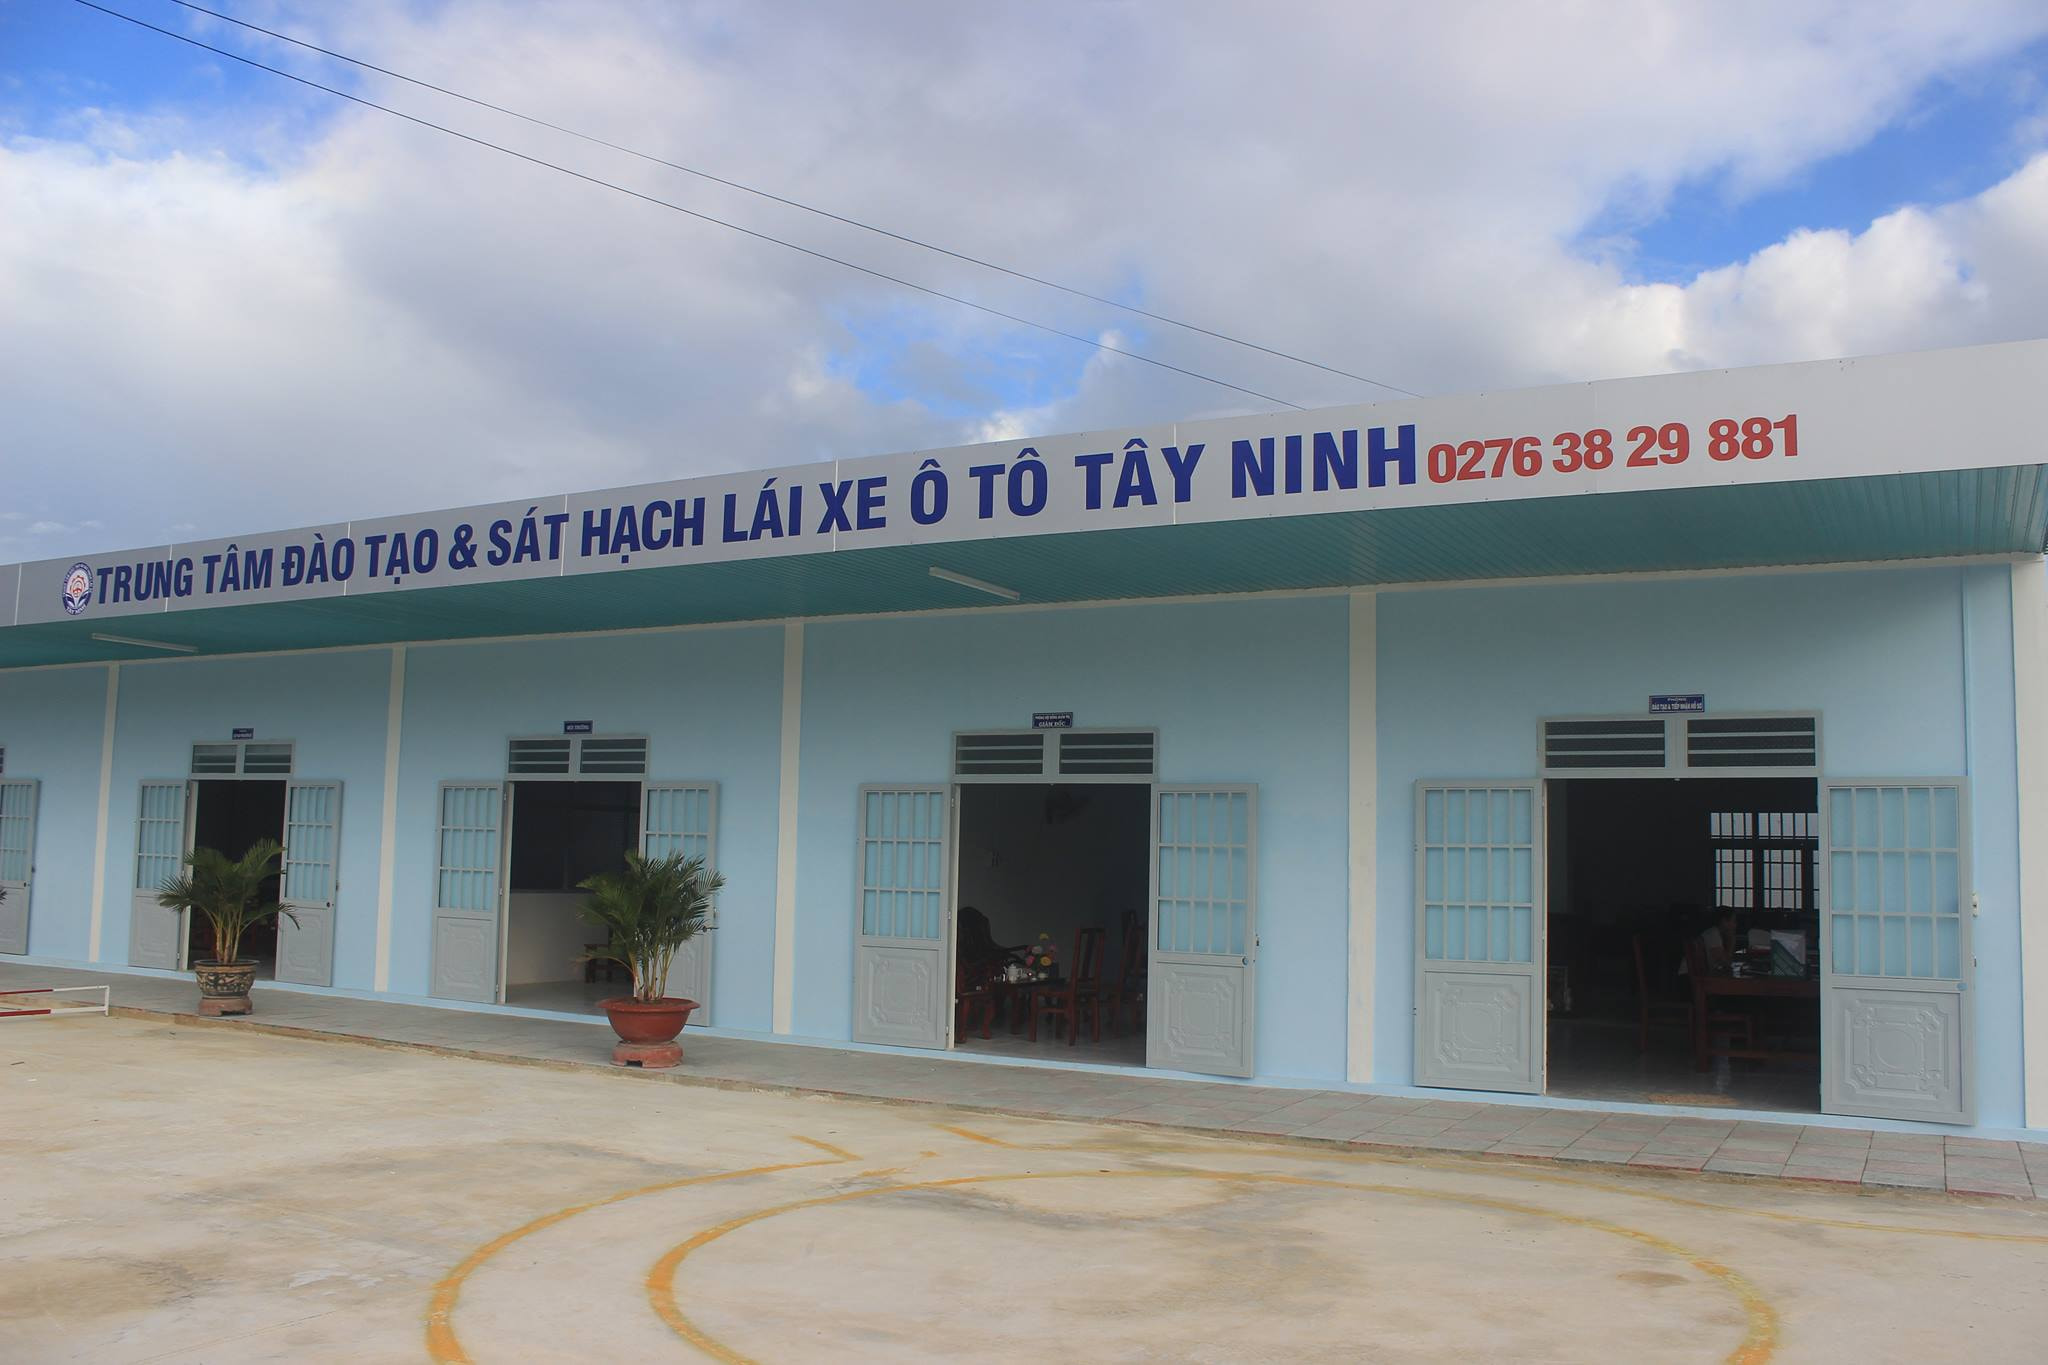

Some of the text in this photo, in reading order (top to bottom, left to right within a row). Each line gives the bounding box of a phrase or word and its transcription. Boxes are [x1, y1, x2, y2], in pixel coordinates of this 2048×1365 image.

[1428, 415, 1797, 483] 0276 38 29 881
[97, 558, 192, 604] TRUNG
[203, 544, 272, 593] TÂM
[282, 534, 354, 586] ĐÀO
[365, 529, 438, 584] TẠO
[448, 524, 477, 569] &
[487, 507, 569, 566] SÁT
[581, 498, 704, 563] HẠCH
[723, 478, 802, 542] LÁI
[818, 477, 887, 533] XE
[911, 459, 948, 524] Ô
[969, 448, 1047, 518] TÔ
[1075, 438, 1205, 509] TÂY
[1232, 424, 1416, 497] NINH
